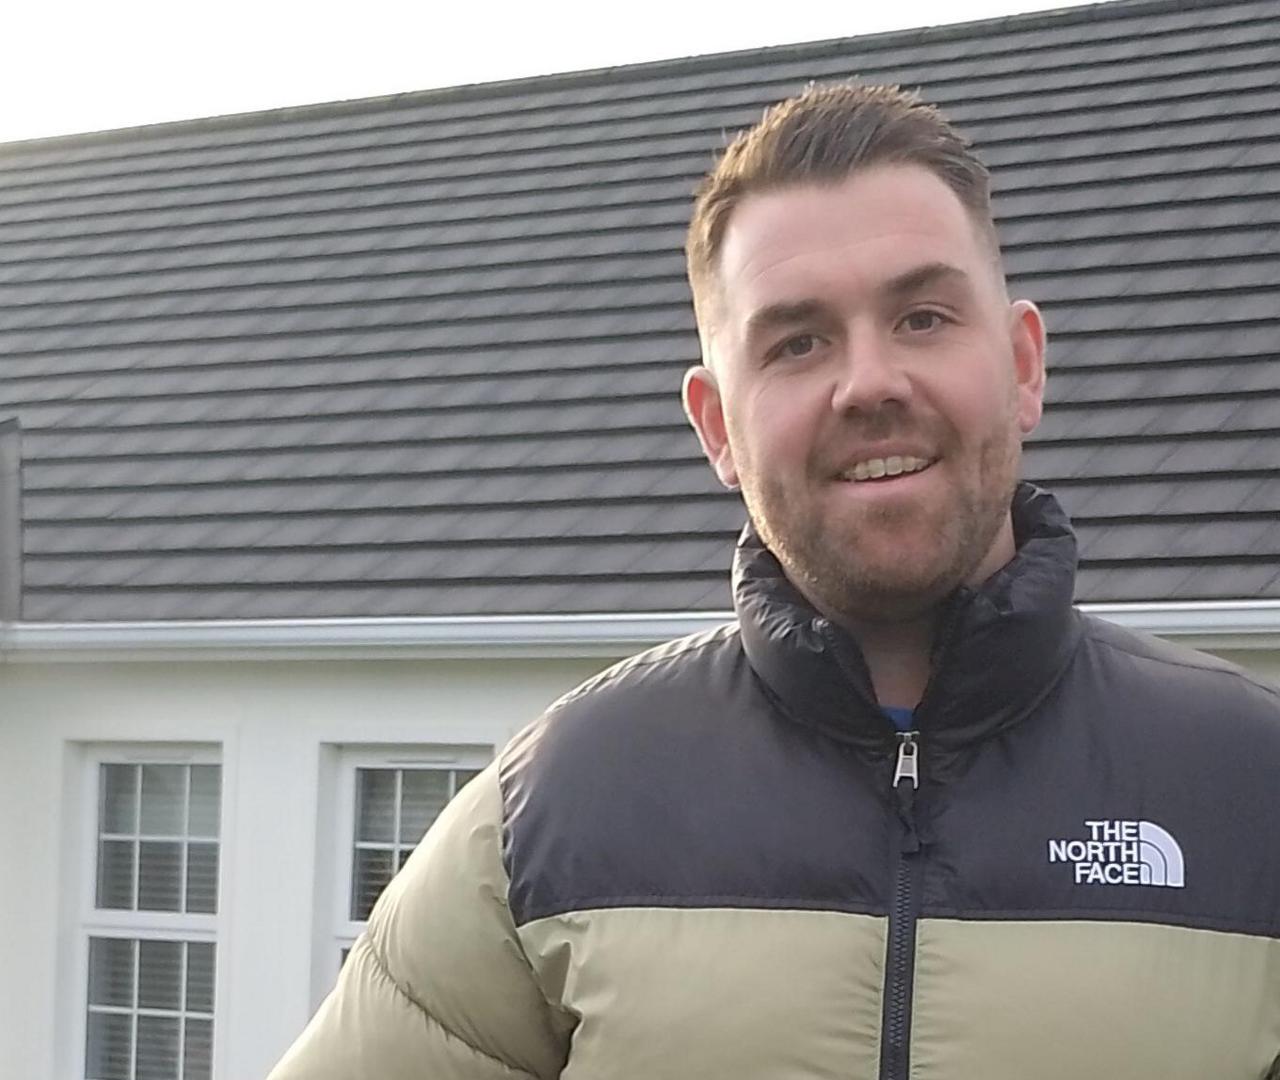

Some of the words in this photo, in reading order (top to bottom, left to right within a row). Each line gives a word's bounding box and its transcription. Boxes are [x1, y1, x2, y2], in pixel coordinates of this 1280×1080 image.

[1084, 820, 1138, 841] THE
[1049, 840, 1138, 863] NORTH
[1074, 861, 1140, 884] FACE
